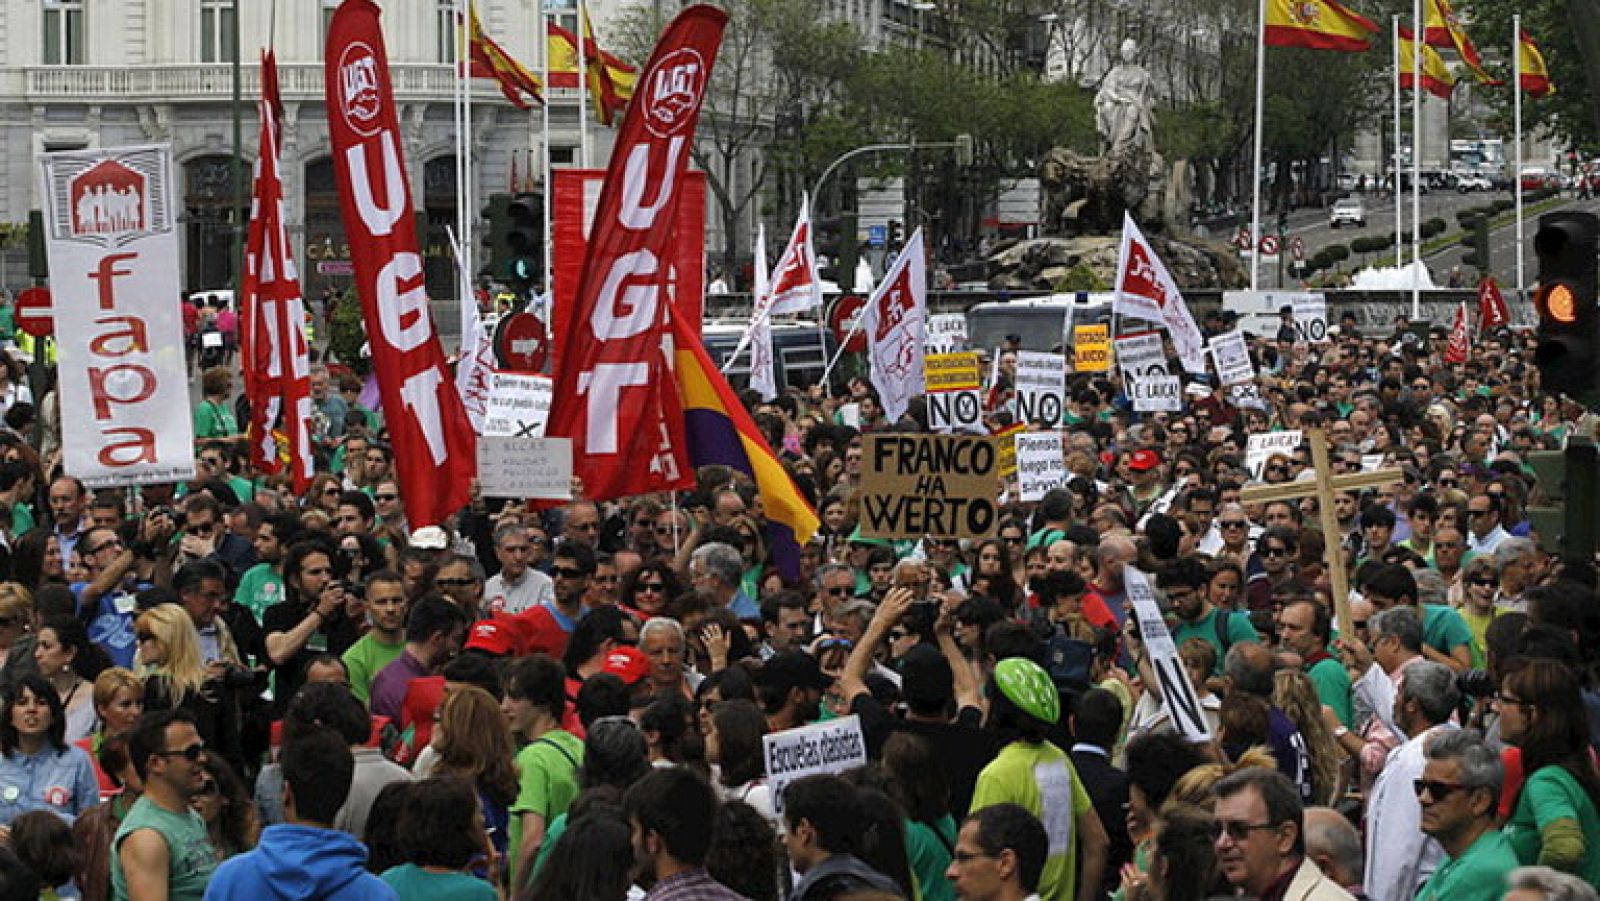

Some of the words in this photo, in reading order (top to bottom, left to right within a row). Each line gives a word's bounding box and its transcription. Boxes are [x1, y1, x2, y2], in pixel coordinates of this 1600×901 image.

[346, 129, 449, 467] UGT
[576, 136, 685, 455] UGT
[87, 251, 159, 468] fapa
[930, 391, 978, 427] NO
[1016, 389, 1062, 426] NO
[874, 437, 993, 475] FRANCO
[915, 475, 946, 496] HA
[864, 494, 993, 534] WERTO
[770, 735, 821, 775] Escuelas
